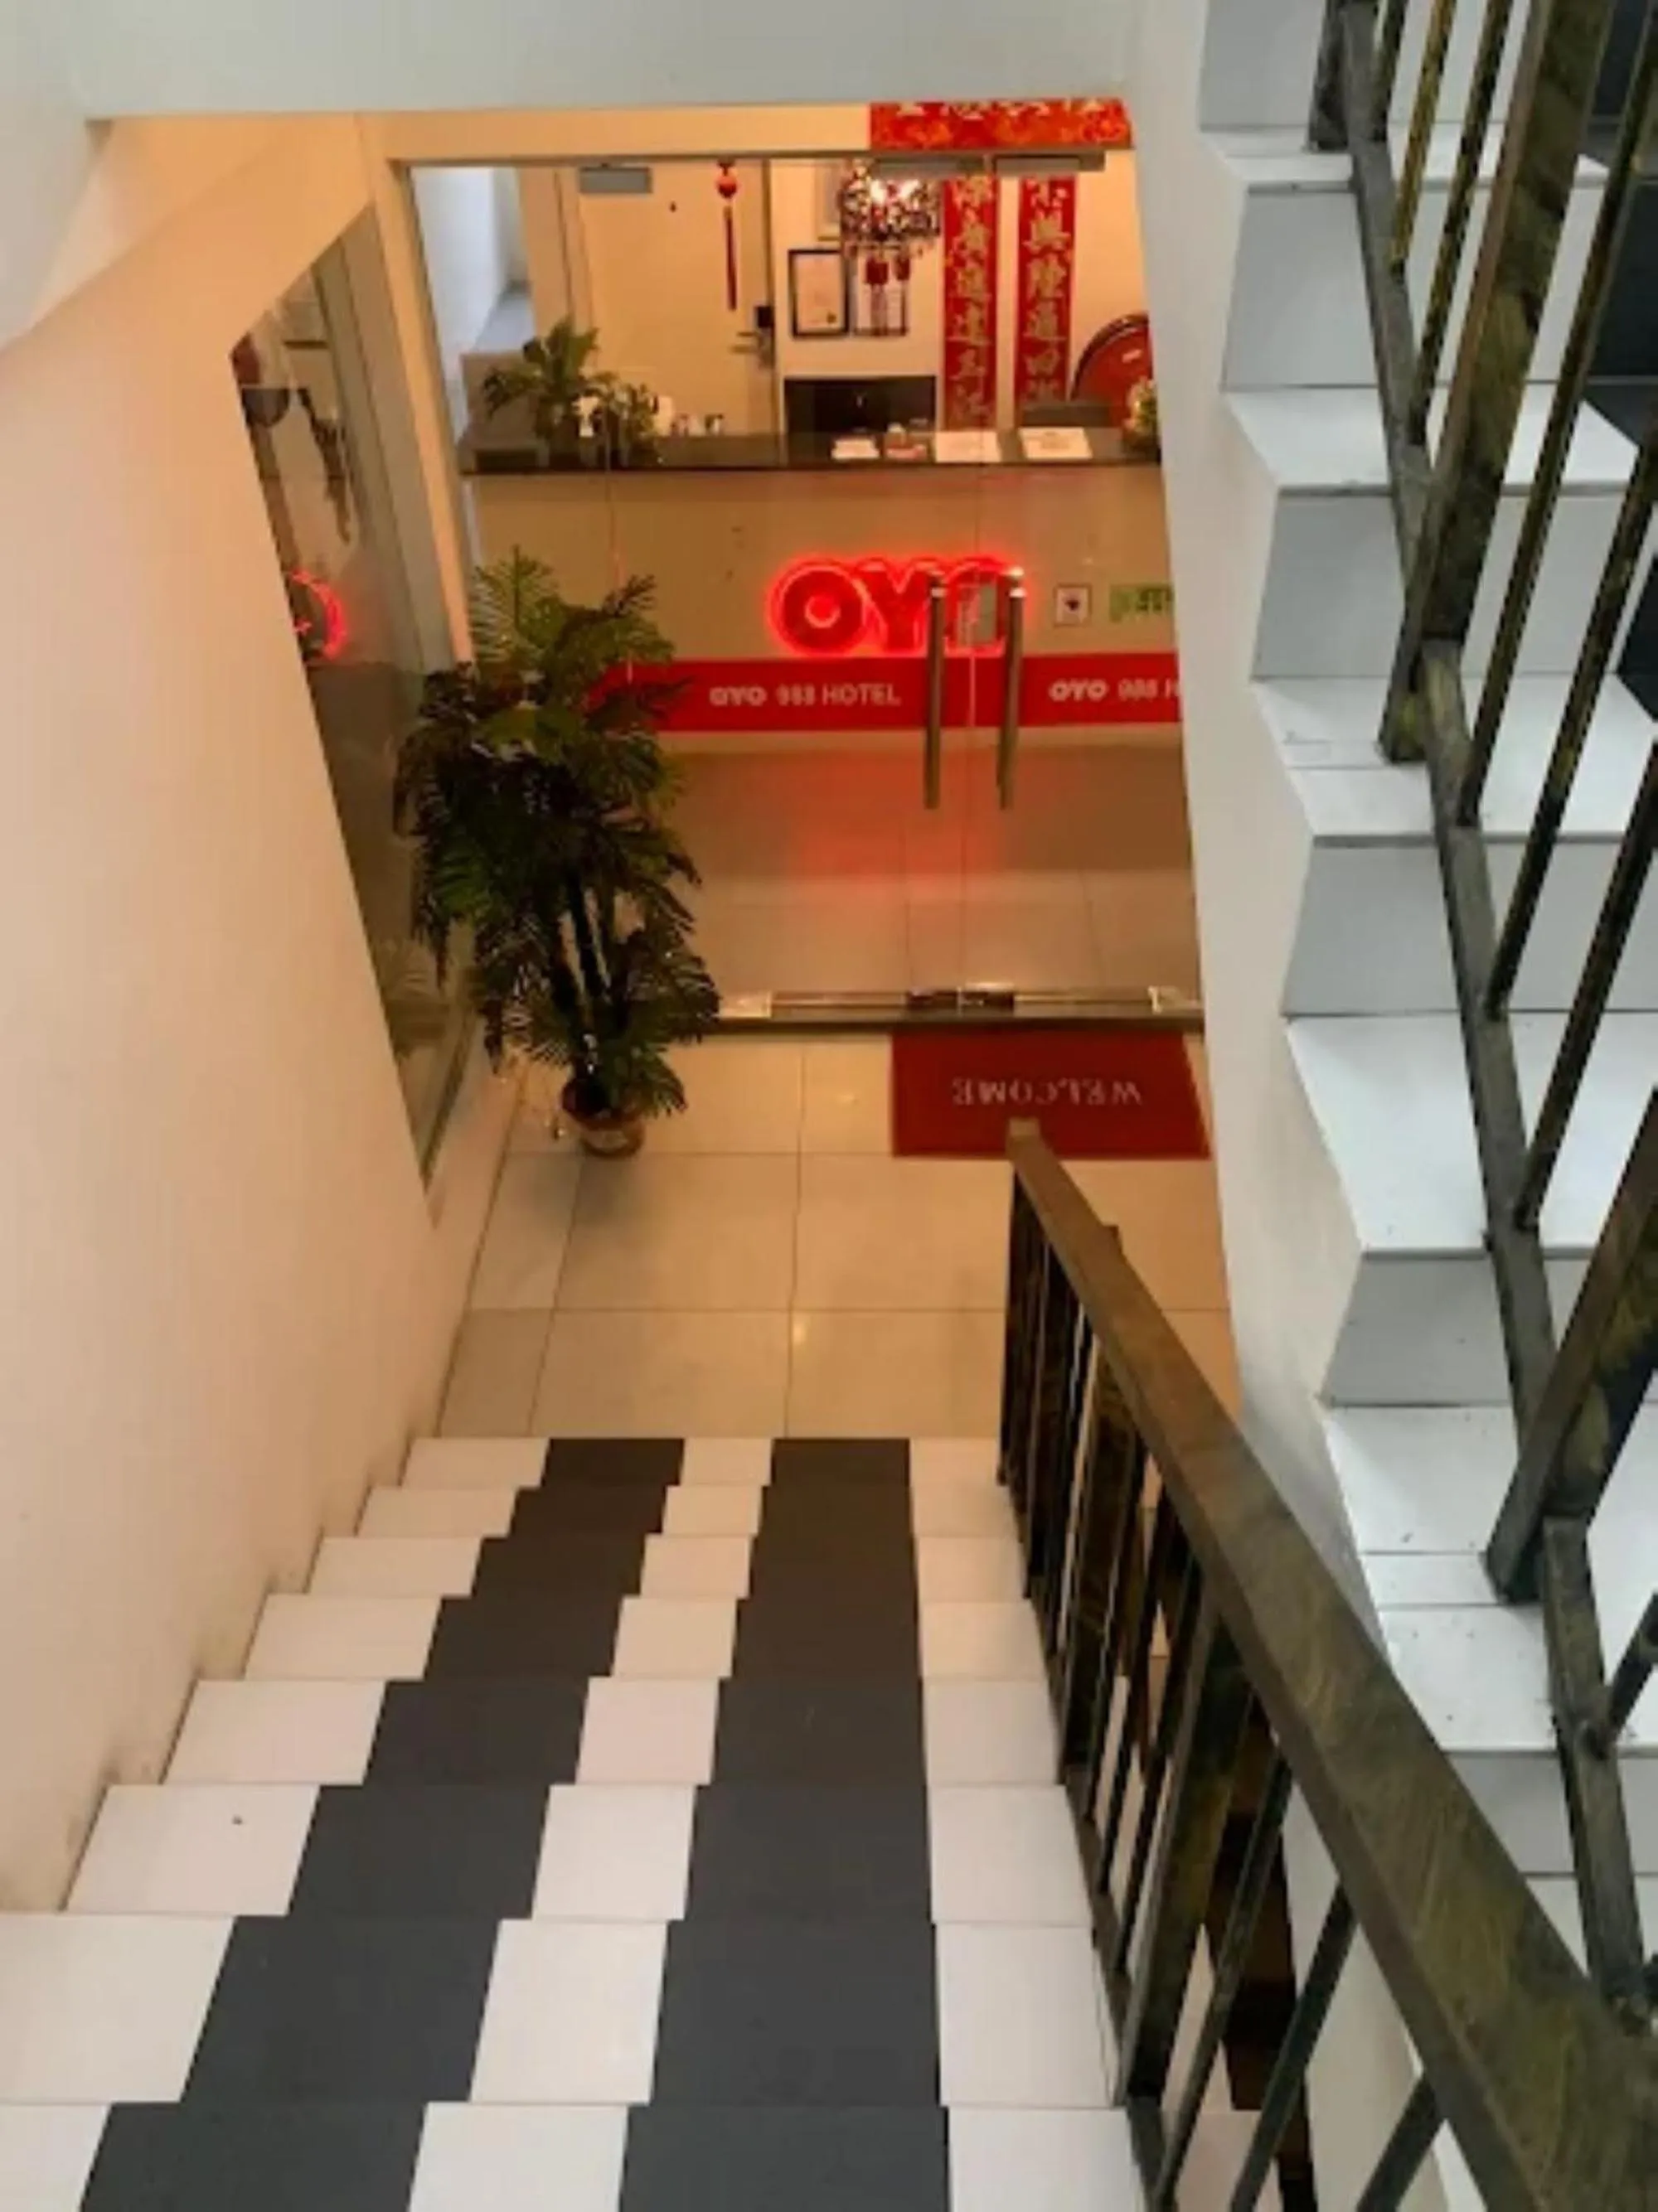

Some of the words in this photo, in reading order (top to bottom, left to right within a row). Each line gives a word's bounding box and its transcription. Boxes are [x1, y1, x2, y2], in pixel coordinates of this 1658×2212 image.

[768, 555, 1023, 656] OYO
[710, 685, 767, 706] OYO
[822, 681, 902, 706] HOTEL
[1049, 678, 1108, 703] OYO
[952, 1077, 1142, 1106] WELCOME
